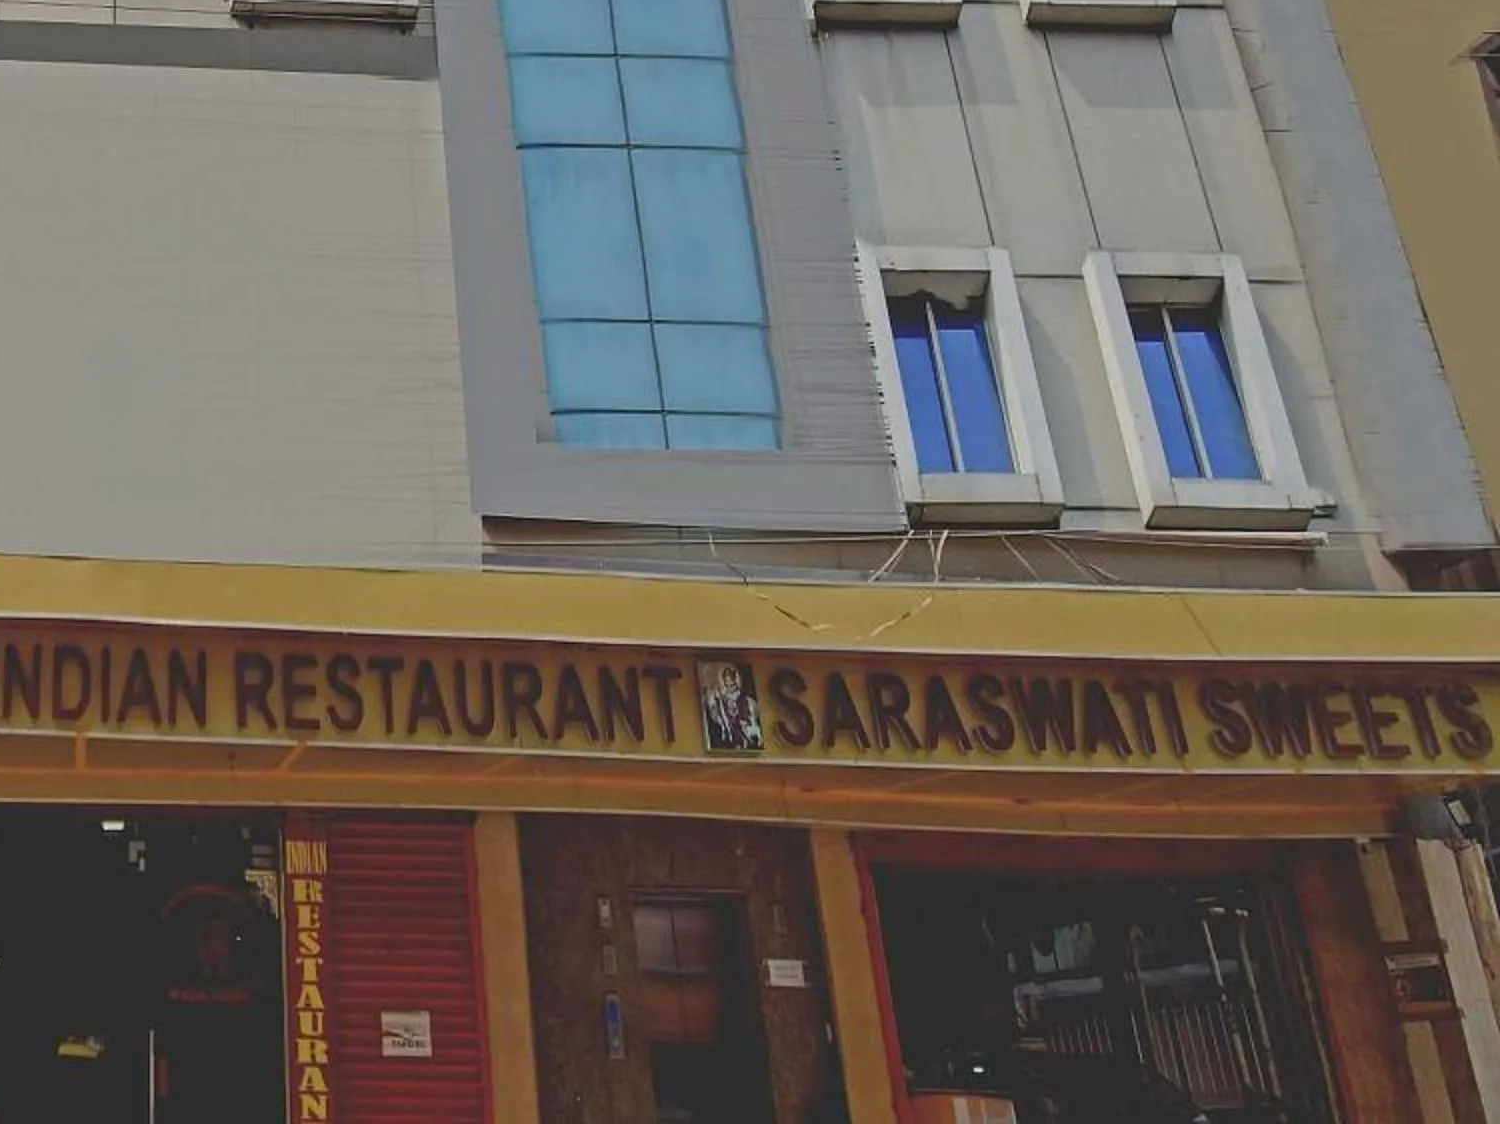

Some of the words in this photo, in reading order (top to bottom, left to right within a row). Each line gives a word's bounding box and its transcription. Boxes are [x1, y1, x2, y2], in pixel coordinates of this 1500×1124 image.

[233, 649, 682, 743] RESTAURANT
[768, 668, 1189, 760] SARASWATI
[1199, 680, 1494, 760] SWEETS
[286, 841, 327, 874] INDIAN
[292, 879, 329, 1124] RESTAURAN
